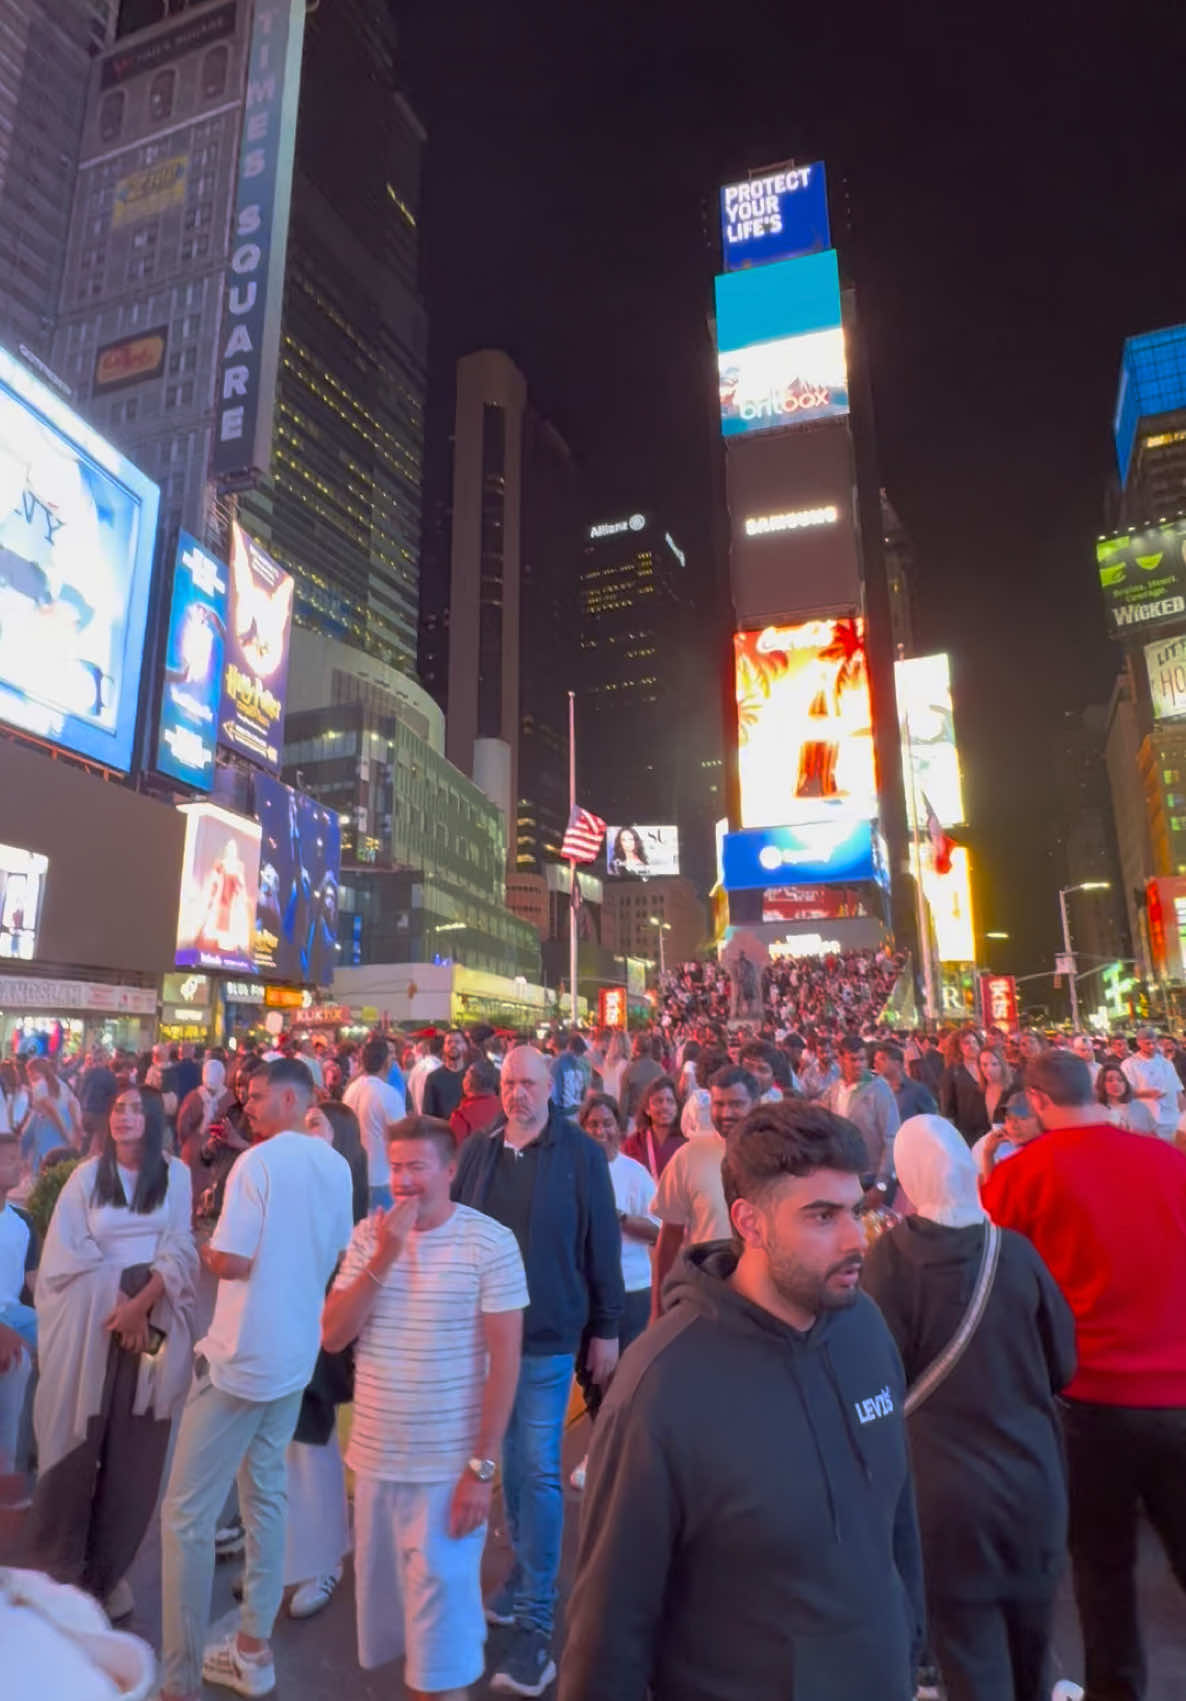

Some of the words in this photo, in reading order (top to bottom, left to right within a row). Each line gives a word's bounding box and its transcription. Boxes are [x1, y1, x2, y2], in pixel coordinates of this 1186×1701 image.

[243, 12, 279, 178] TIMES
[725, 168, 811, 206] PROTECT
[726, 195, 780, 223] YOUR
[727, 214, 783, 243] LIFE'S
[221, 205, 261, 442] SQUARE
[590, 521, 628, 538] Allianz
